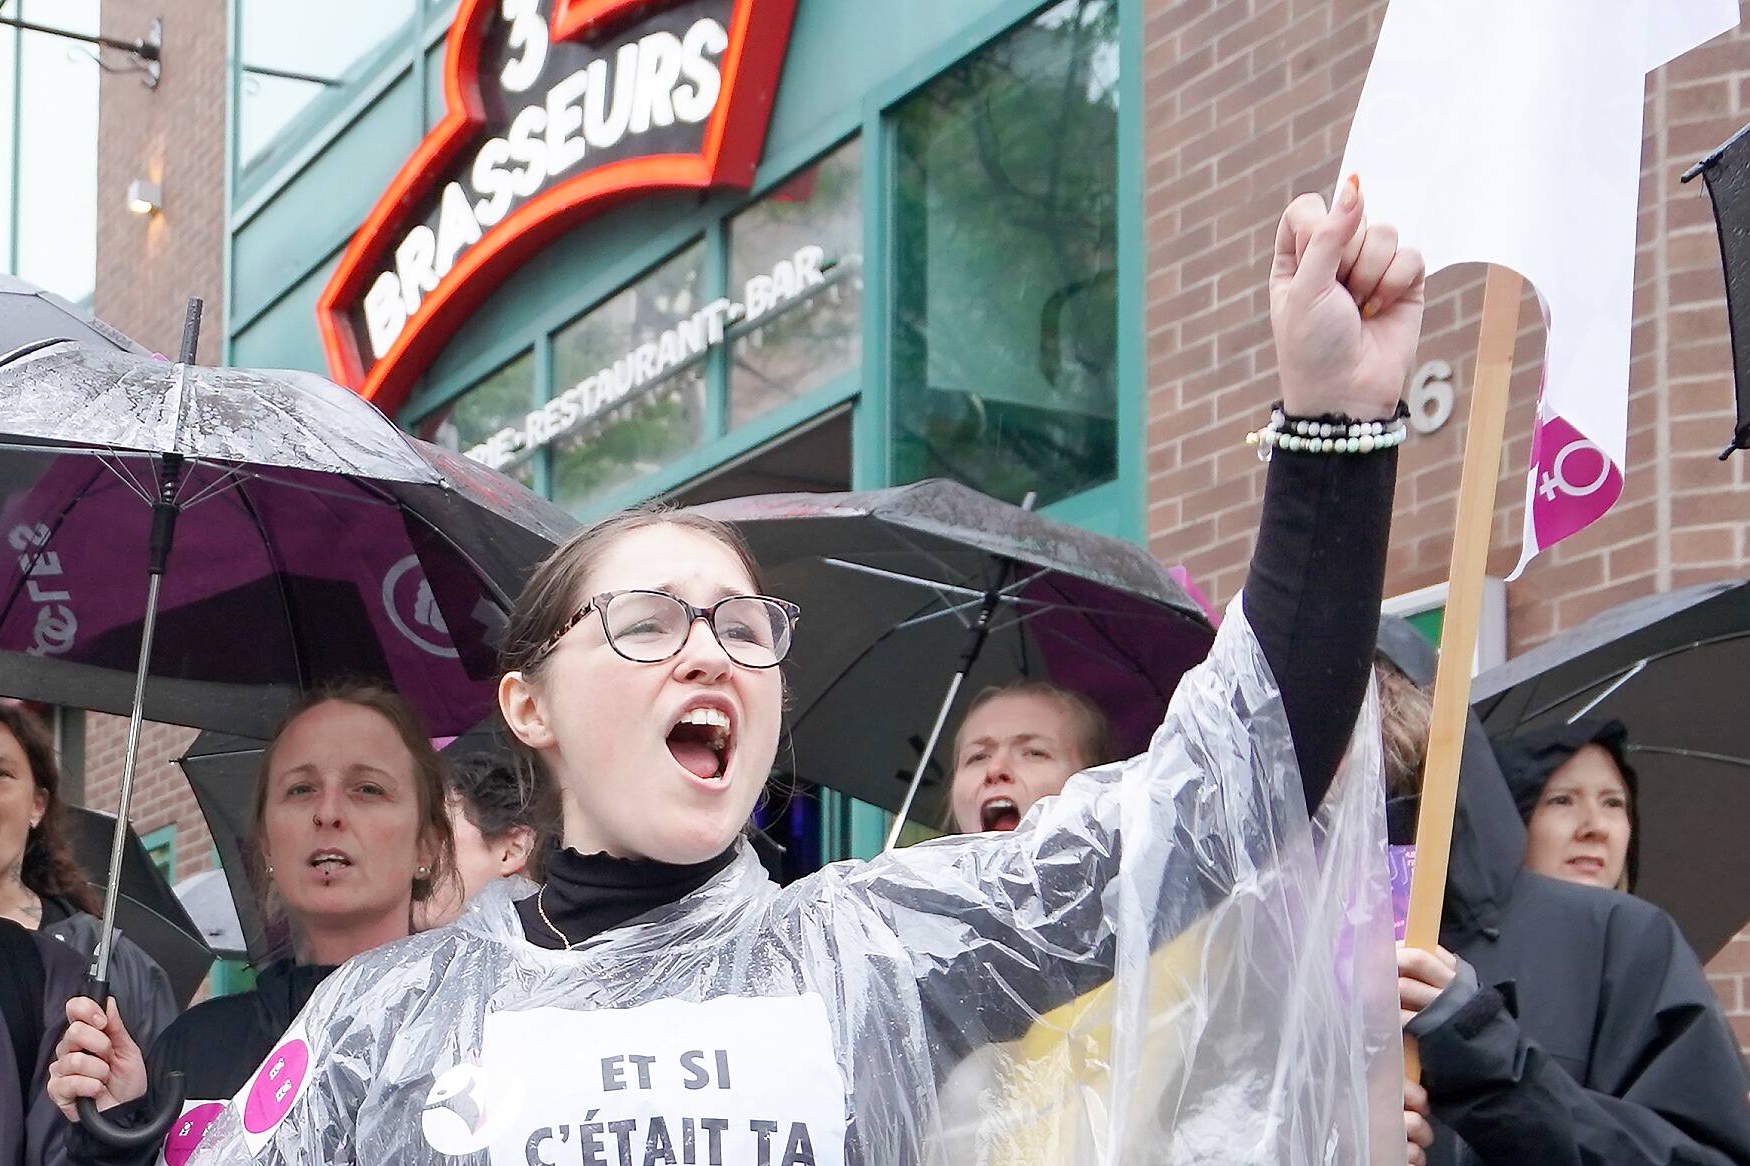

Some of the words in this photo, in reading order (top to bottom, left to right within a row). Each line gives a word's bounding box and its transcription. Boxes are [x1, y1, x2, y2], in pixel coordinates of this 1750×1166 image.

[499, 0, 550, 92] 3
[362, 17, 730, 360] BRASSEURS
[525, 298, 730, 449] RESTAURANT
[745, 245, 825, 321] BAR
[1408, 359, 1454, 433] 6
[601, 1054, 656, 1092] ET
[680, 1049, 731, 1090] SI
